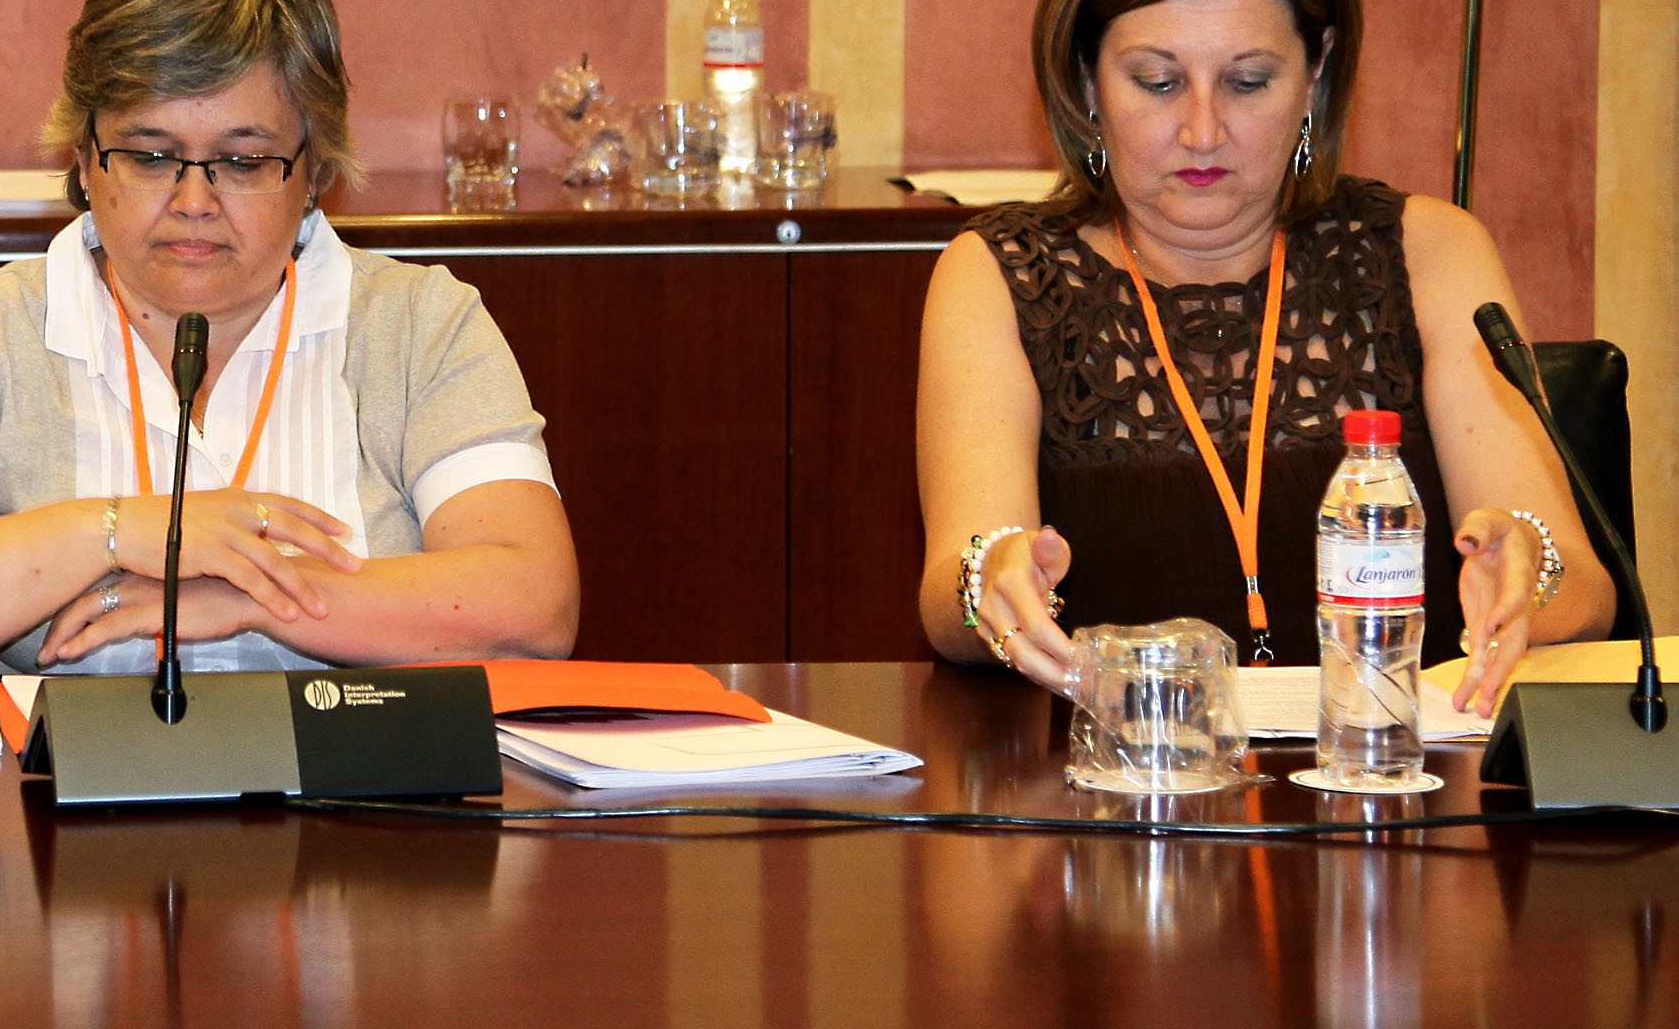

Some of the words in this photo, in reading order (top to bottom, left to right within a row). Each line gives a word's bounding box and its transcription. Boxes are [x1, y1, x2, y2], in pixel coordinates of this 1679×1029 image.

[1356, 566, 1417, 584] Lanjarón
[343, 684, 375, 692] Danish
[344, 691, 406, 700] Interpretation
[345, 698, 384, 706] Systems
